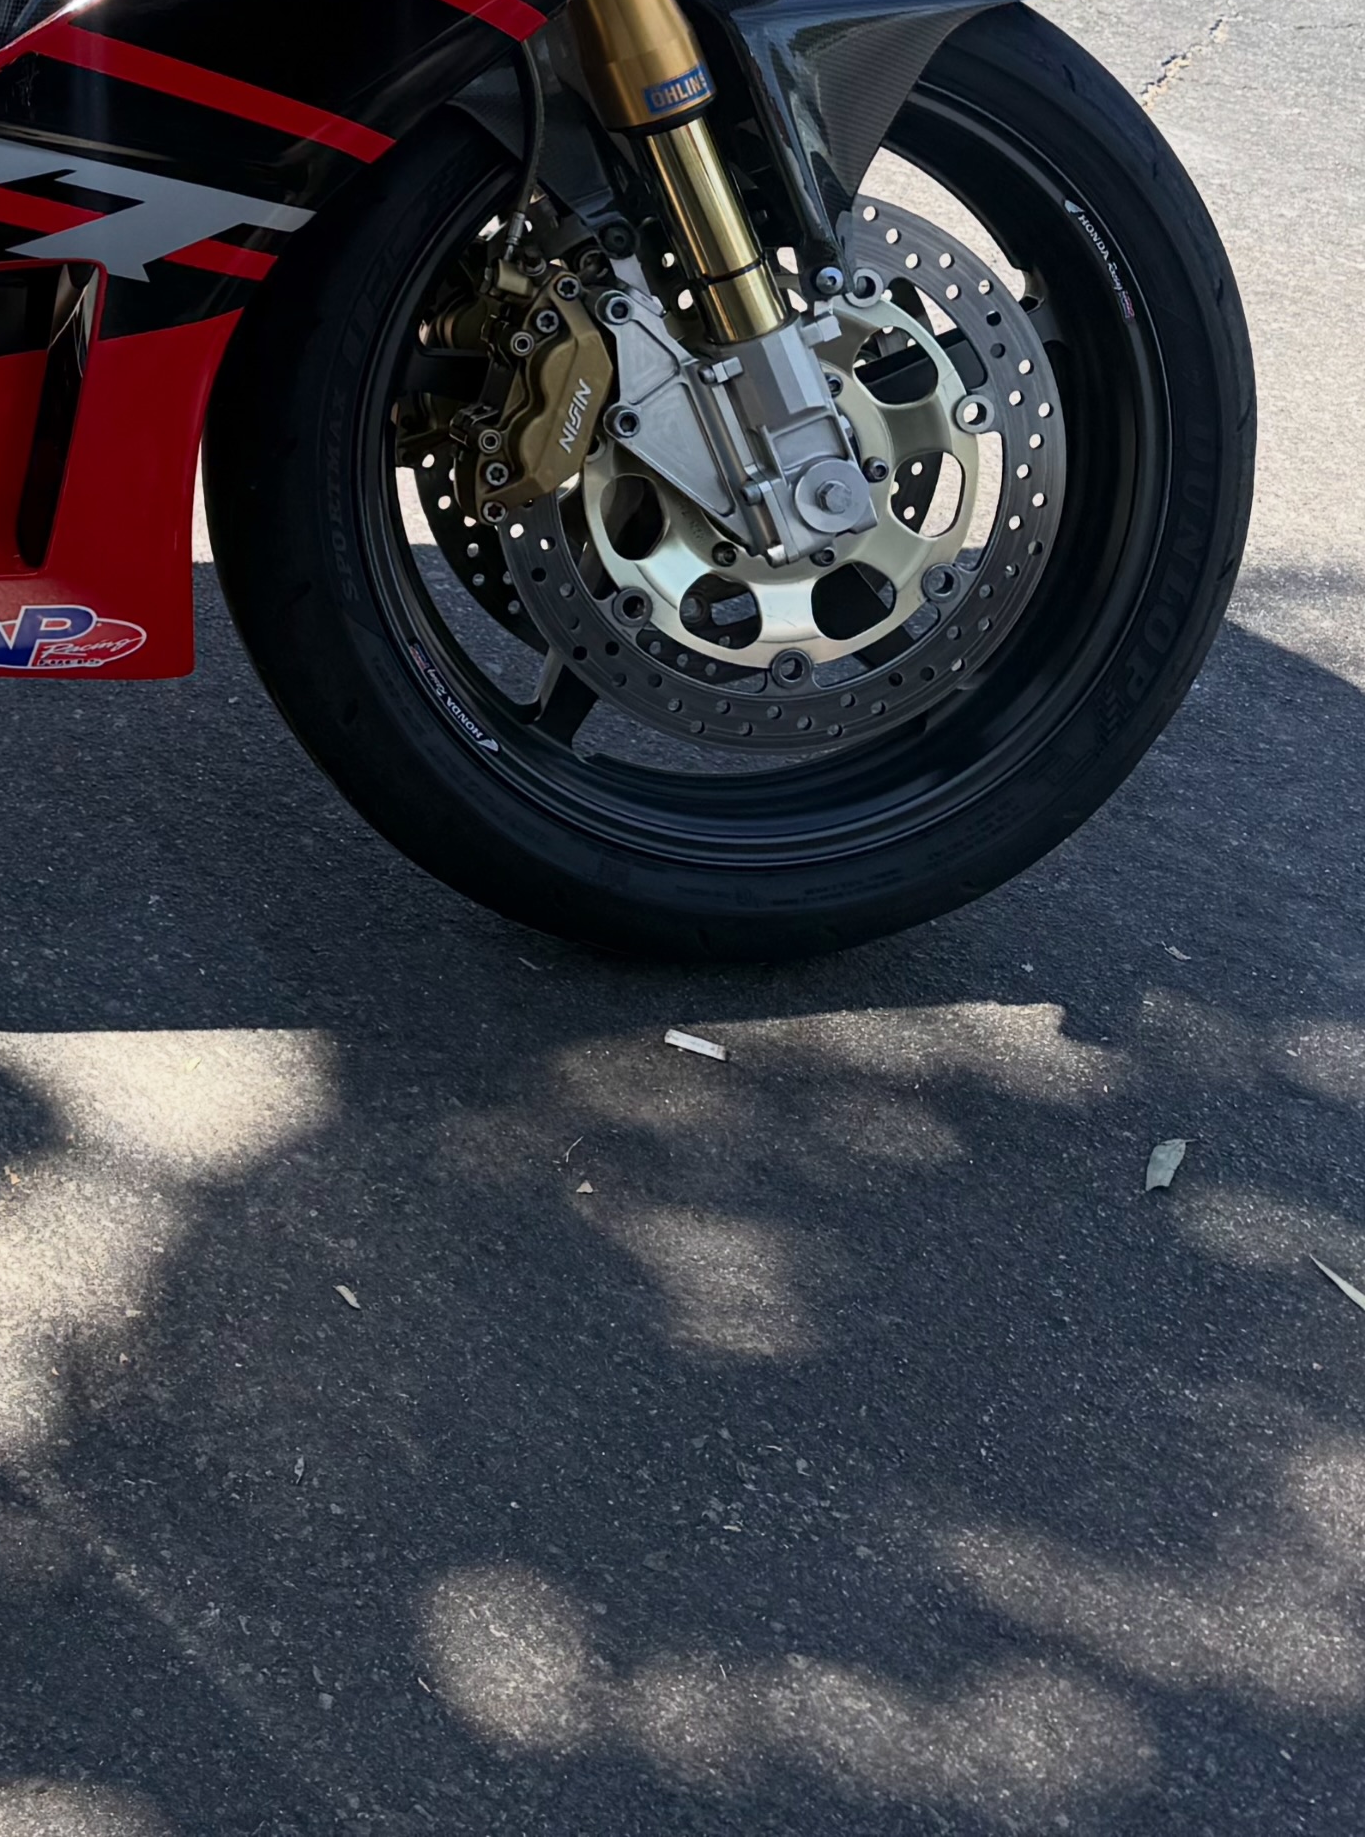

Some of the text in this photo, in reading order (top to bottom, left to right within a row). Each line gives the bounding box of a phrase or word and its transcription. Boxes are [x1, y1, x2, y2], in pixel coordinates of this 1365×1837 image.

[1077, 214, 1110, 261] HONDA
[558, 377, 592, 454] NISSIN
[446, 696, 484, 739] HONDA
